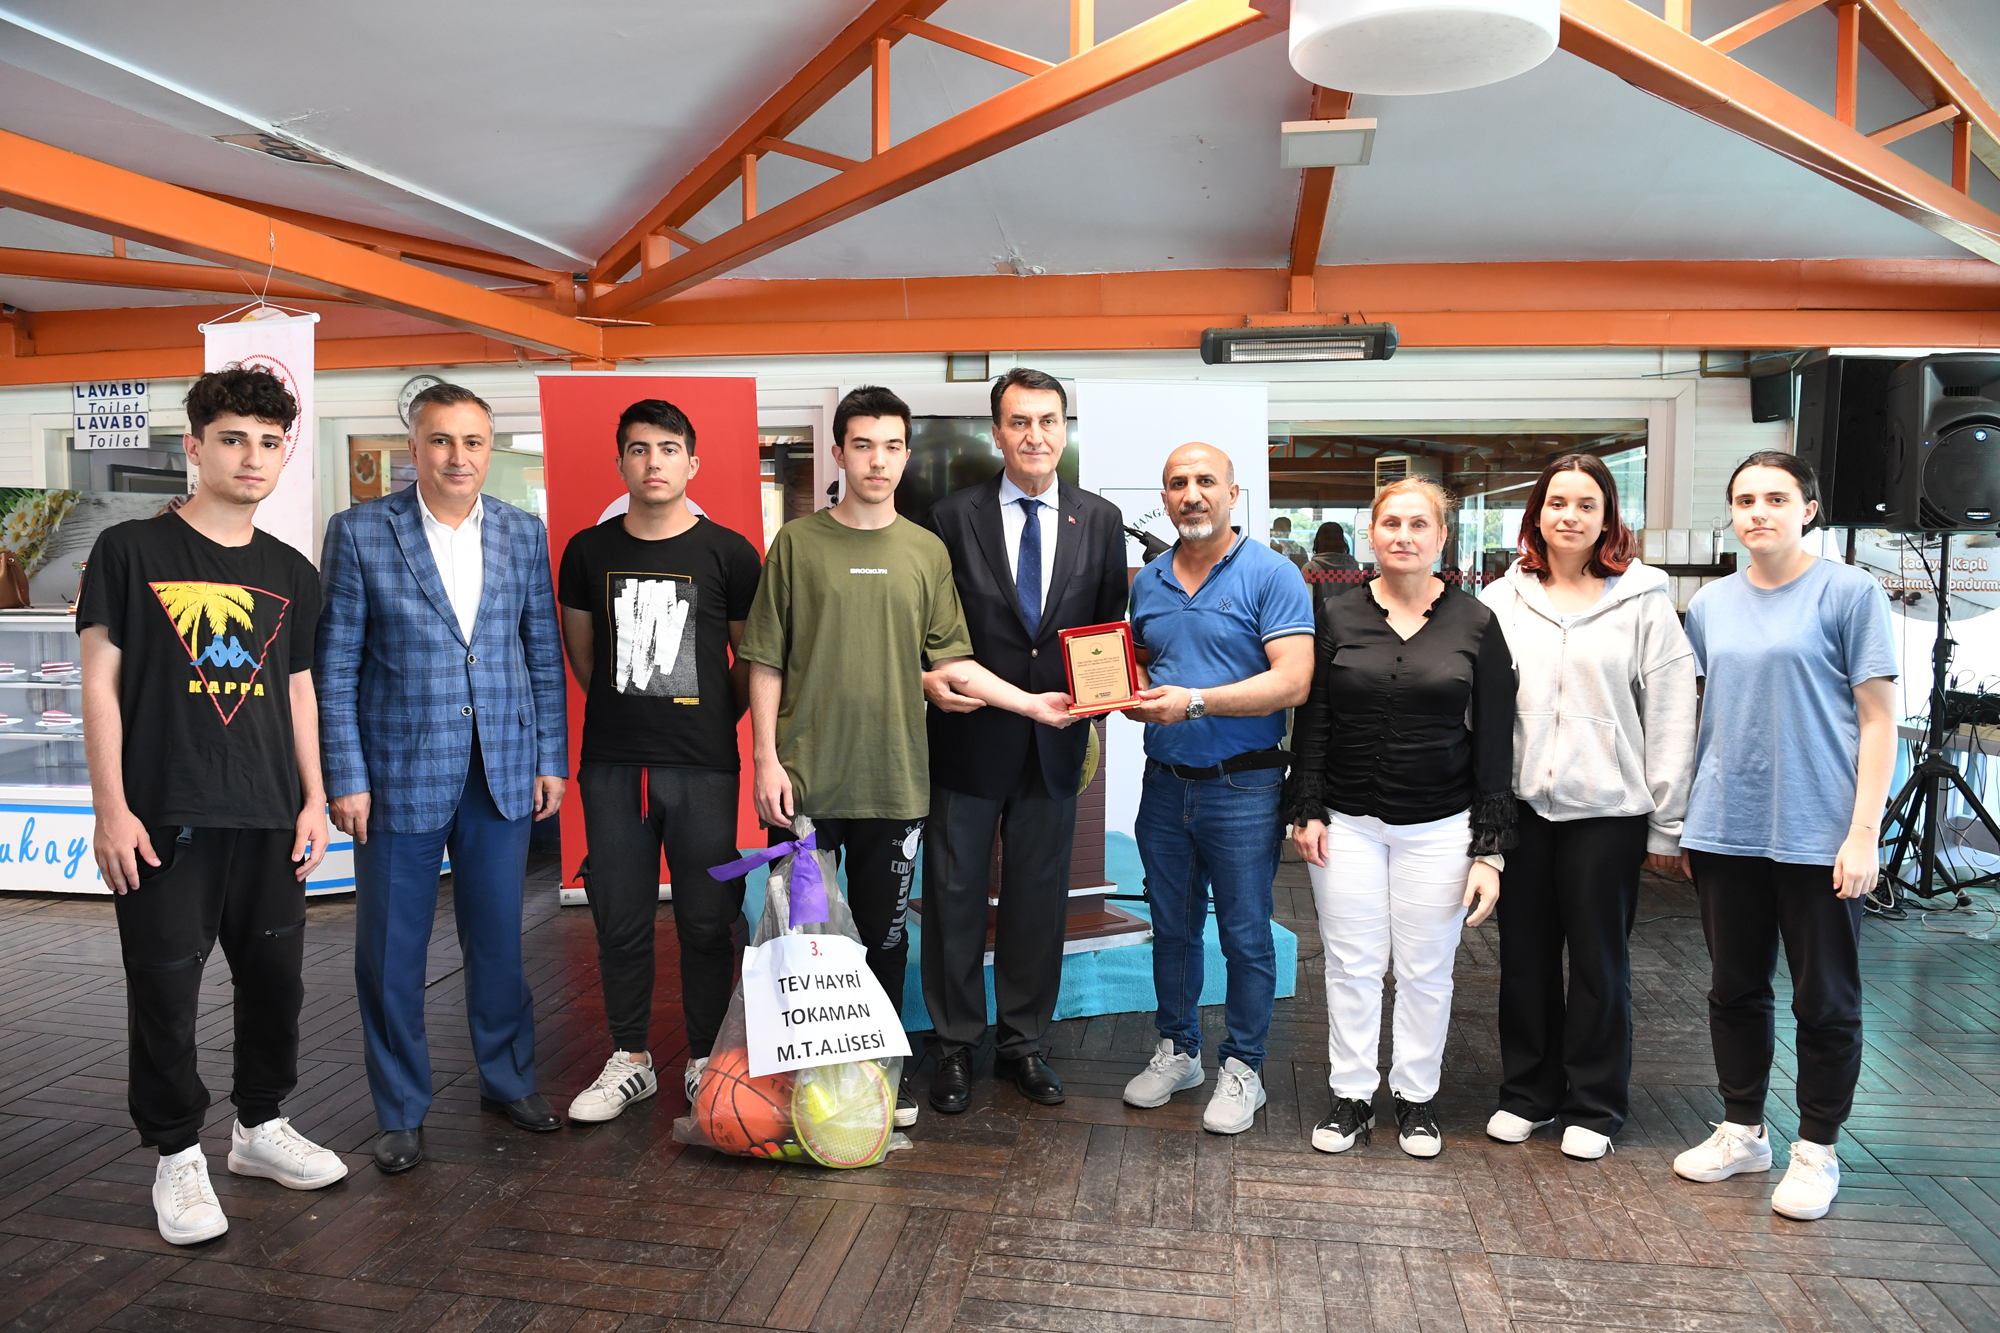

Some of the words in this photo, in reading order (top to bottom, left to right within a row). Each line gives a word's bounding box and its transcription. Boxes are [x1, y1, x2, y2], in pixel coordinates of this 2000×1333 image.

[76, 383, 145, 398] LAVABO
[89, 401, 139, 413] Toilet
[77, 415, 146, 430] LAVABO
[89, 434, 139, 448] Toilet
[1952, 558, 1988, 573] Kaplı
[1879, 577, 1935, 593] Kızarmış
[189, 680, 265, 697] KAPPA
[810, 941, 823, 957] 3.
[778, 974, 811, 994] TEV
[814, 970, 861, 990] HAYRİ
[781, 1003, 871, 1027] TOKAMAN
[777, 1029, 886, 1063] M.T.A.LİSESİ
